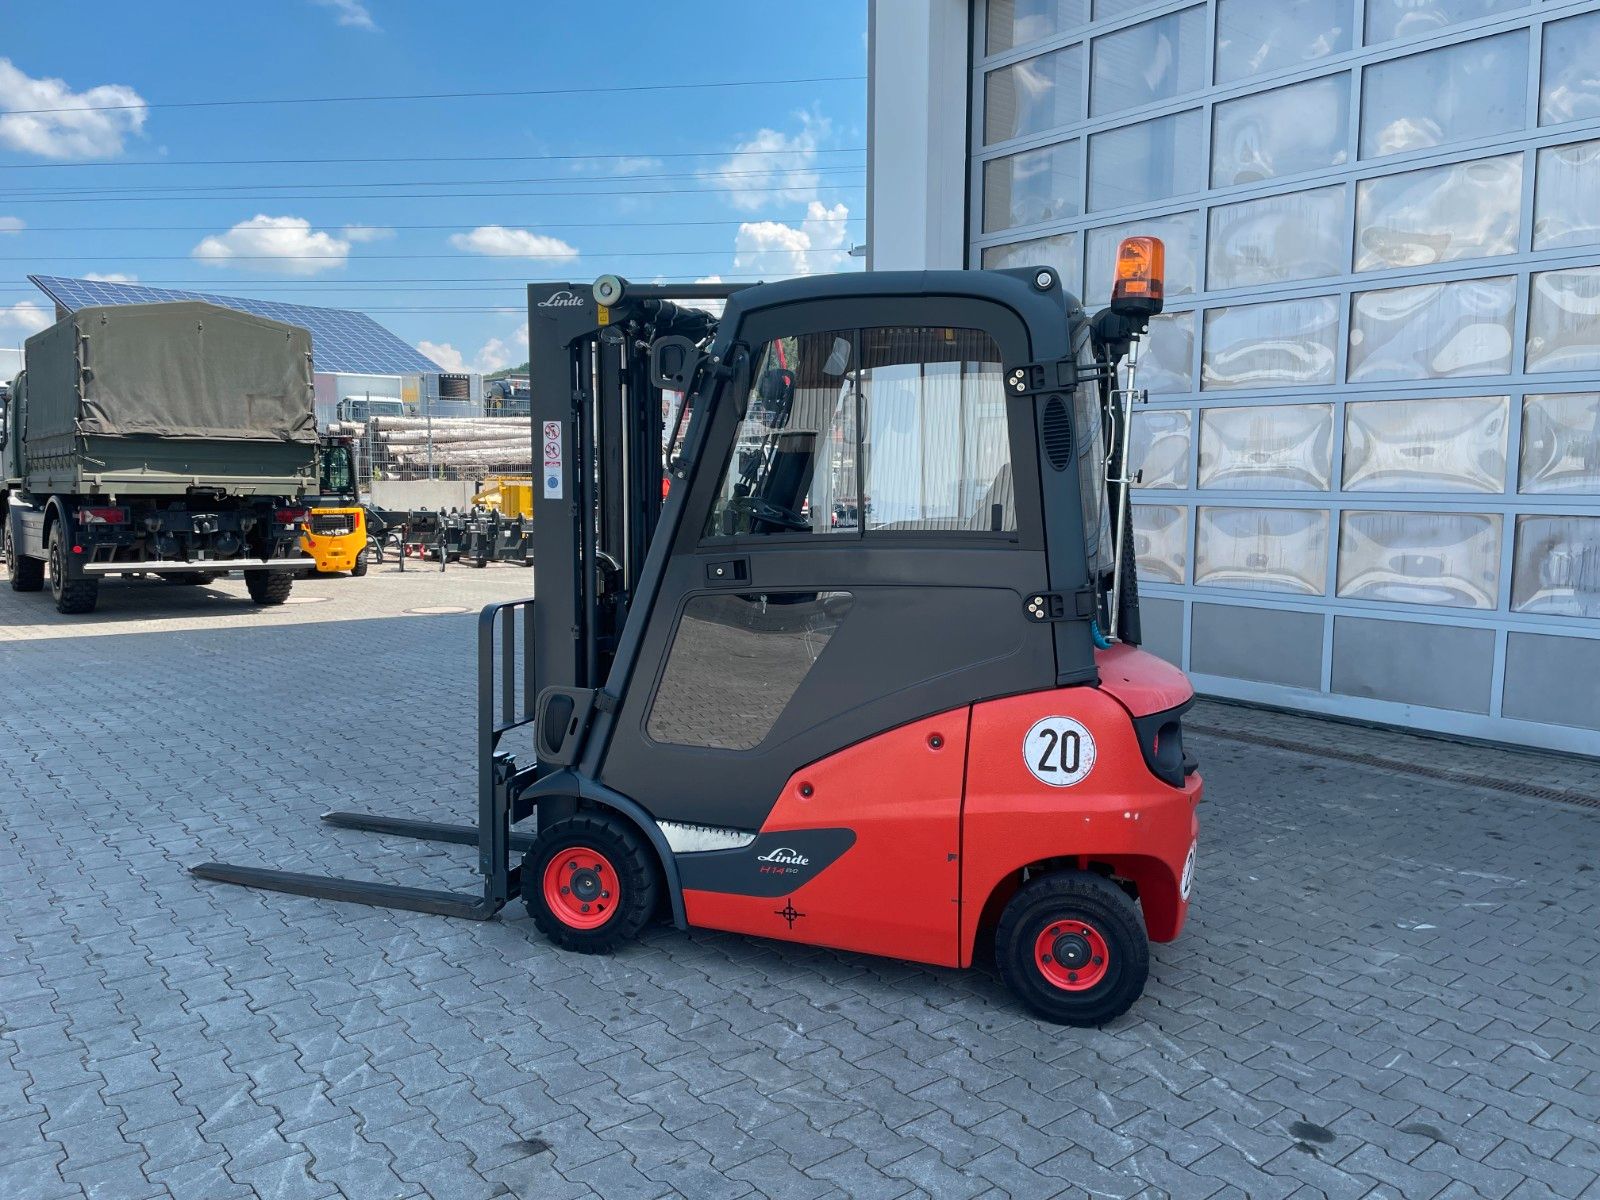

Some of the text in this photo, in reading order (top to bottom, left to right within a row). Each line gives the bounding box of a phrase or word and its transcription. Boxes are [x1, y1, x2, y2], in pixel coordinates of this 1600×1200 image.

[538, 291, 584, 307] Linde
[1038, 728, 1081, 774] 20
[757, 847, 809, 866] Linde
